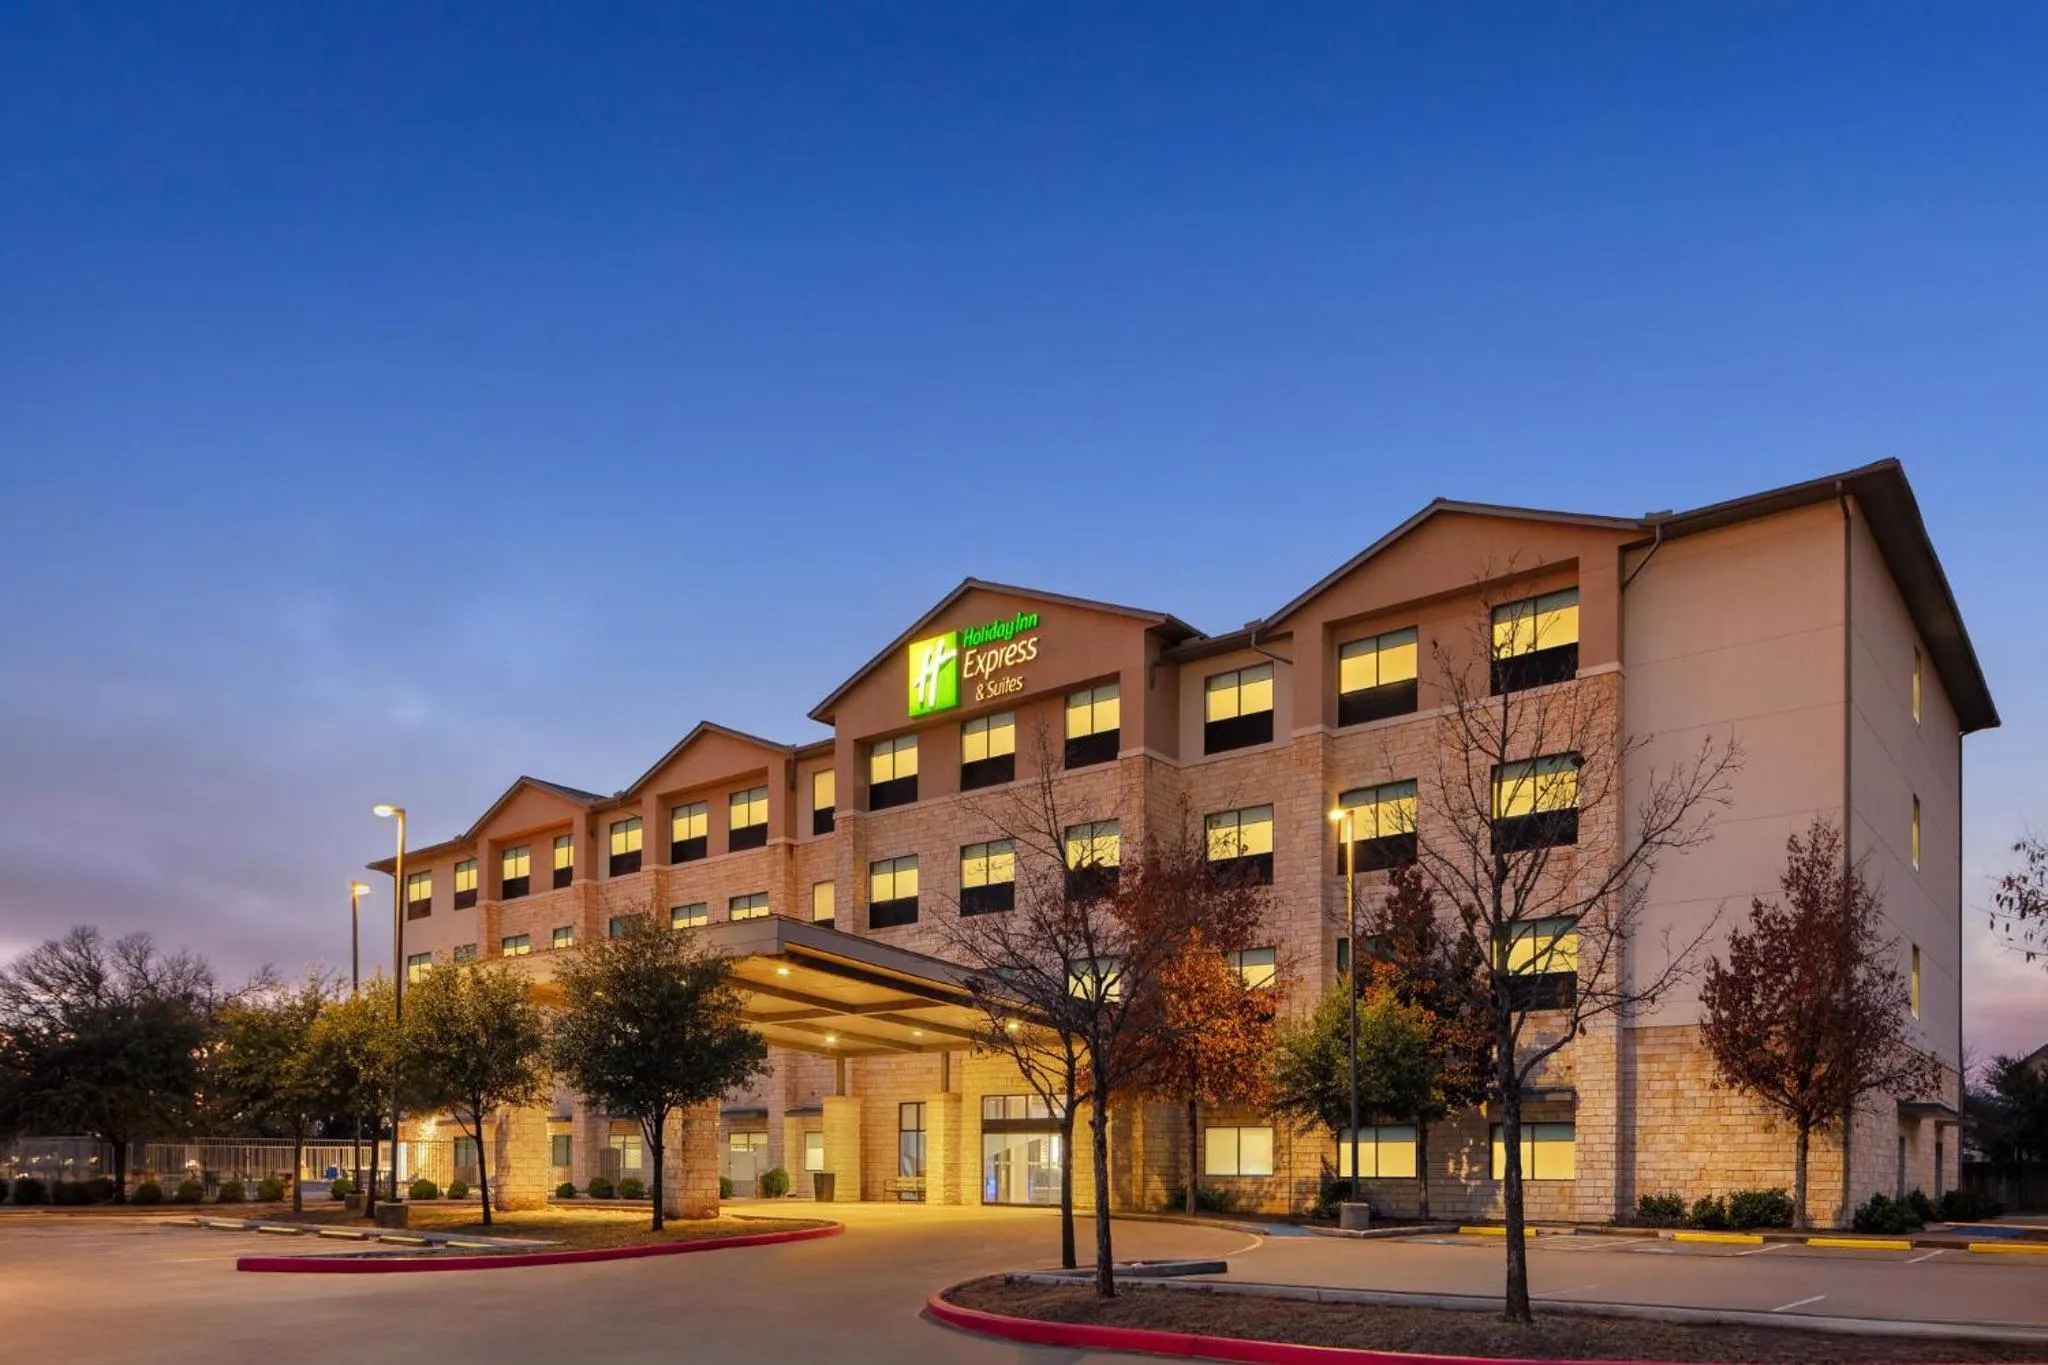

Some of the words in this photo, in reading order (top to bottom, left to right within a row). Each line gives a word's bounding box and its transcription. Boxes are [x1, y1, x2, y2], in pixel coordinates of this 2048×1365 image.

[963, 619, 1014, 648] Holiday
[1015, 611, 1039, 633] Inn
[963, 637, 1039, 680] Express
[975, 683, 985, 701] &
[986, 676, 1024, 698] Suites
